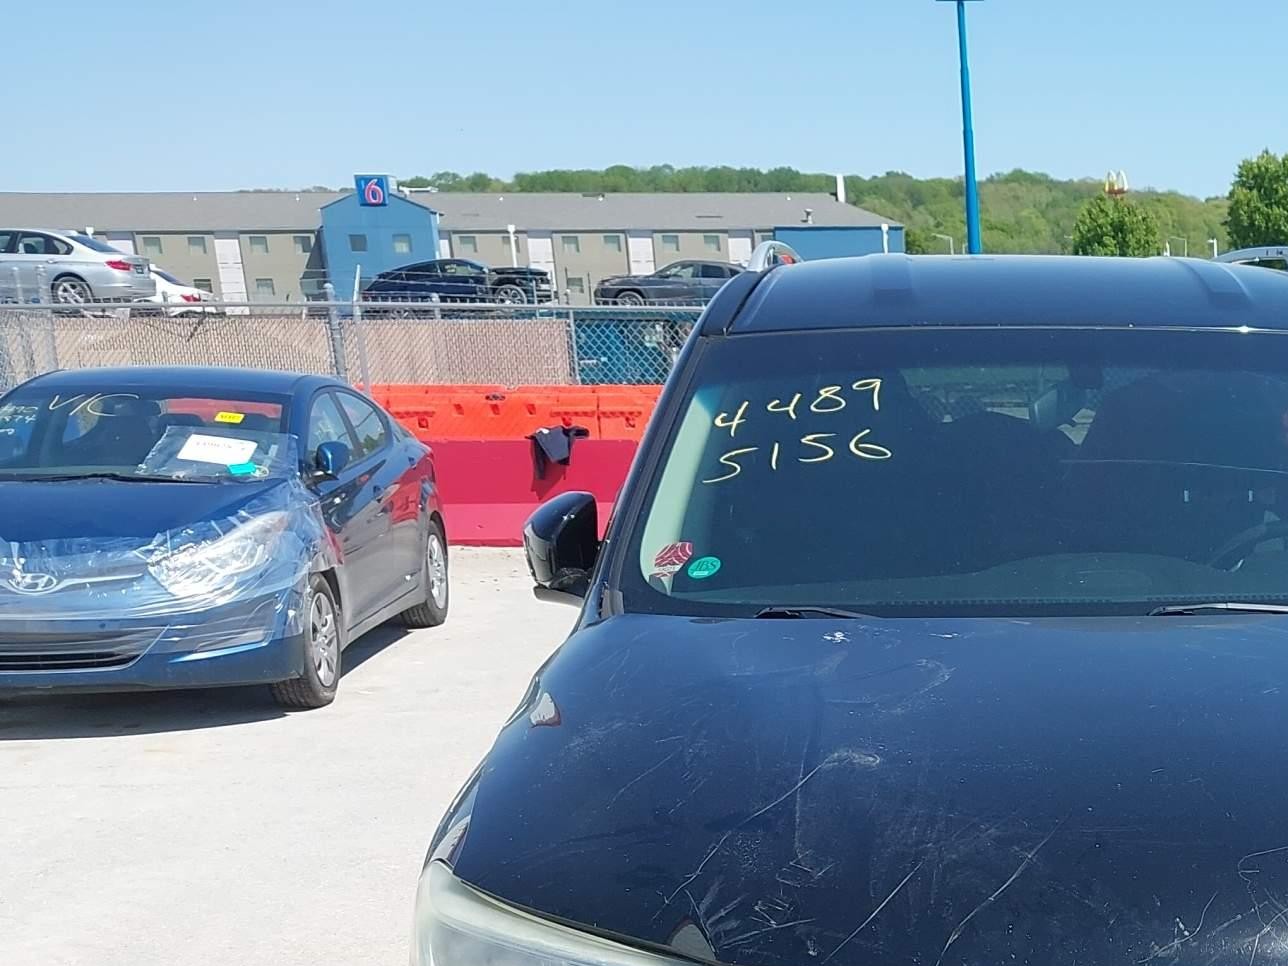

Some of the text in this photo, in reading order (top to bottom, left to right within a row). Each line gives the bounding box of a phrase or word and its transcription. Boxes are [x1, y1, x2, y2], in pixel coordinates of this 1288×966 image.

[365, 178, 384, 204] 6
[714, 378, 882, 437] 4489
[702, 429, 892, 484] 5156
